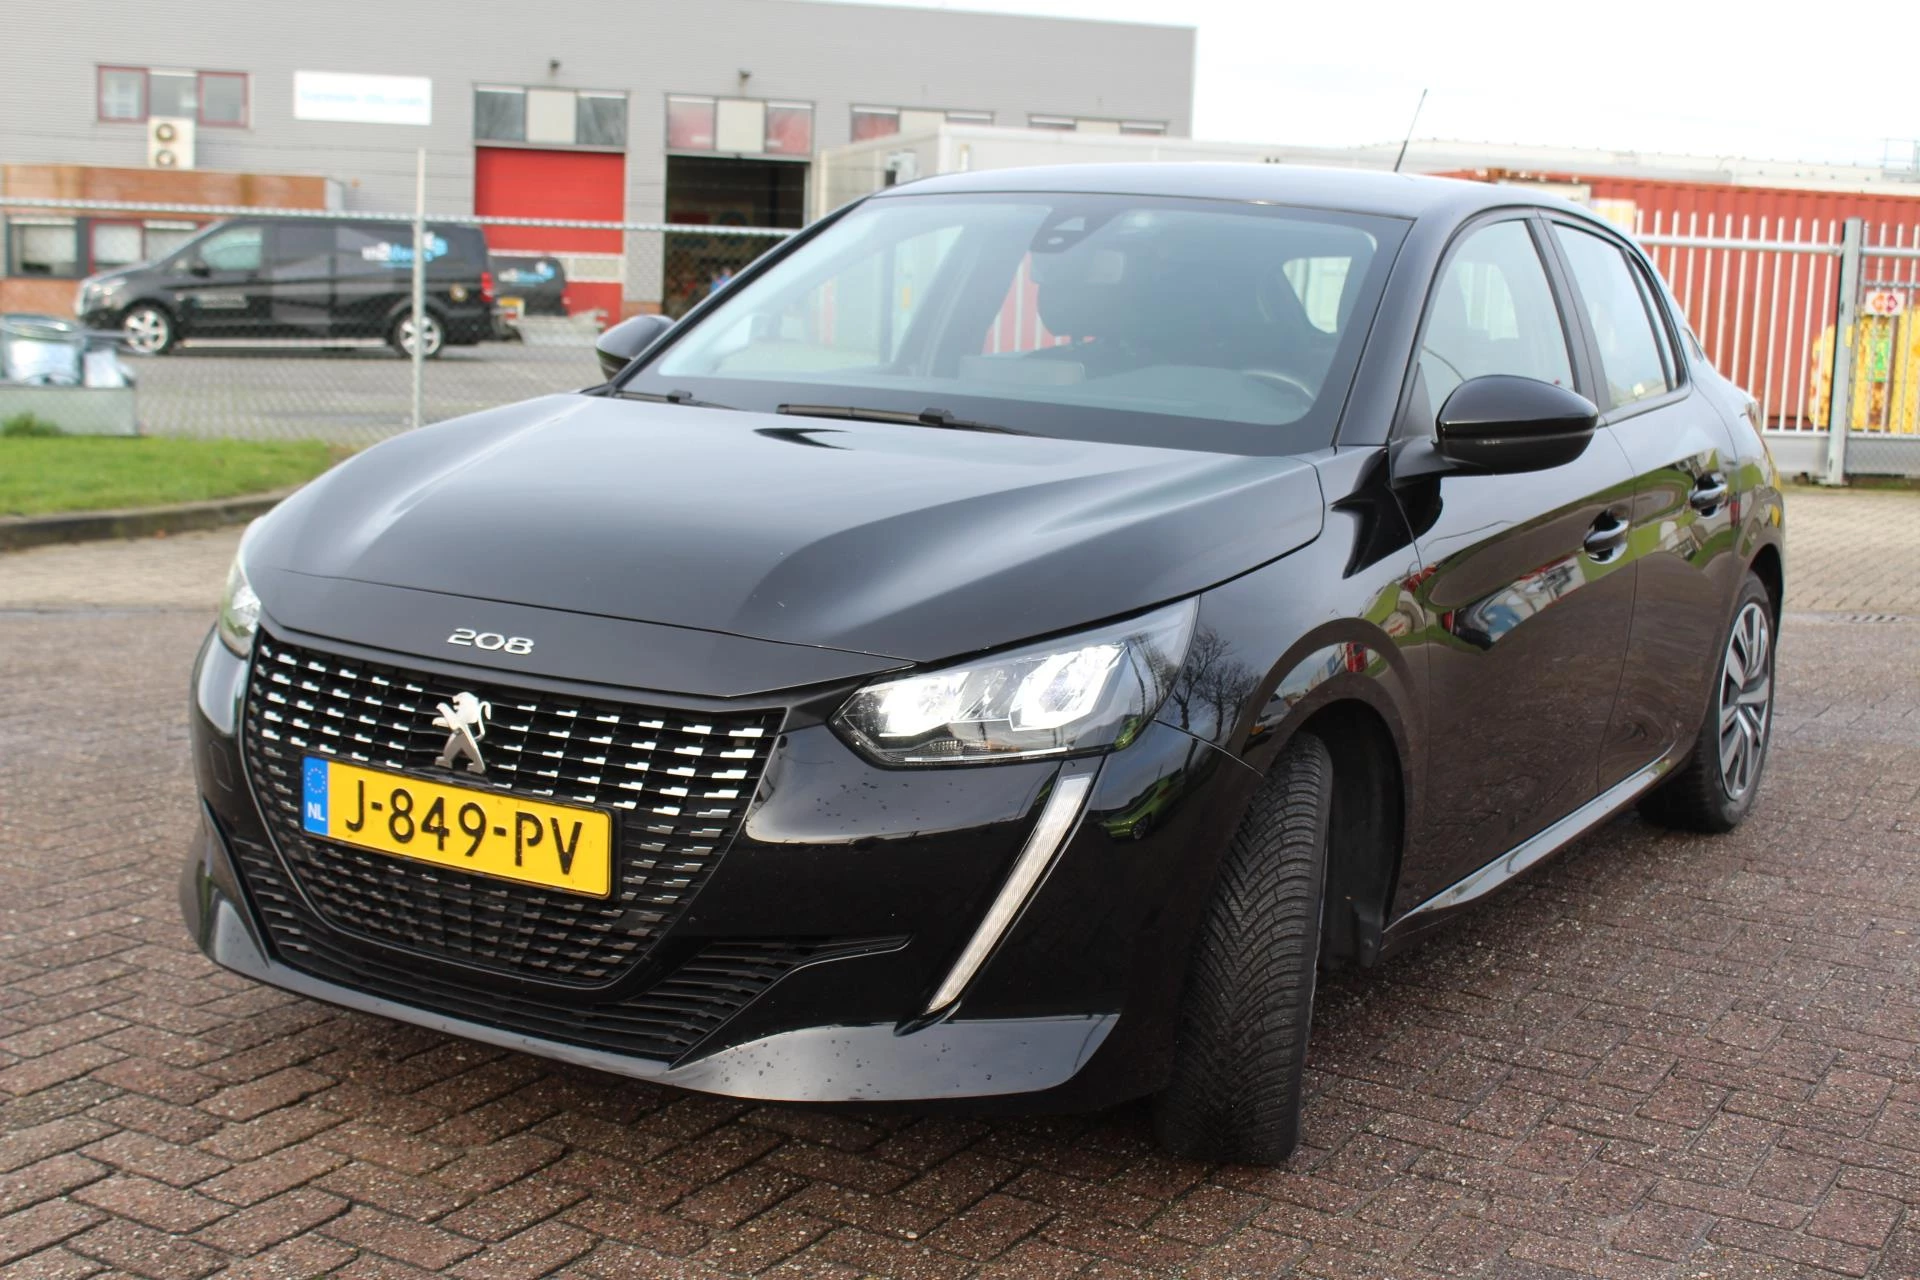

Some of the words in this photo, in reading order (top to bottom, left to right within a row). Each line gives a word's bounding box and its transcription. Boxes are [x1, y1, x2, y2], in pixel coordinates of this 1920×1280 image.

[447, 627, 534, 655] 208
[308, 801, 326, 821] NL
[345, 779, 583, 875] J-849-PV
